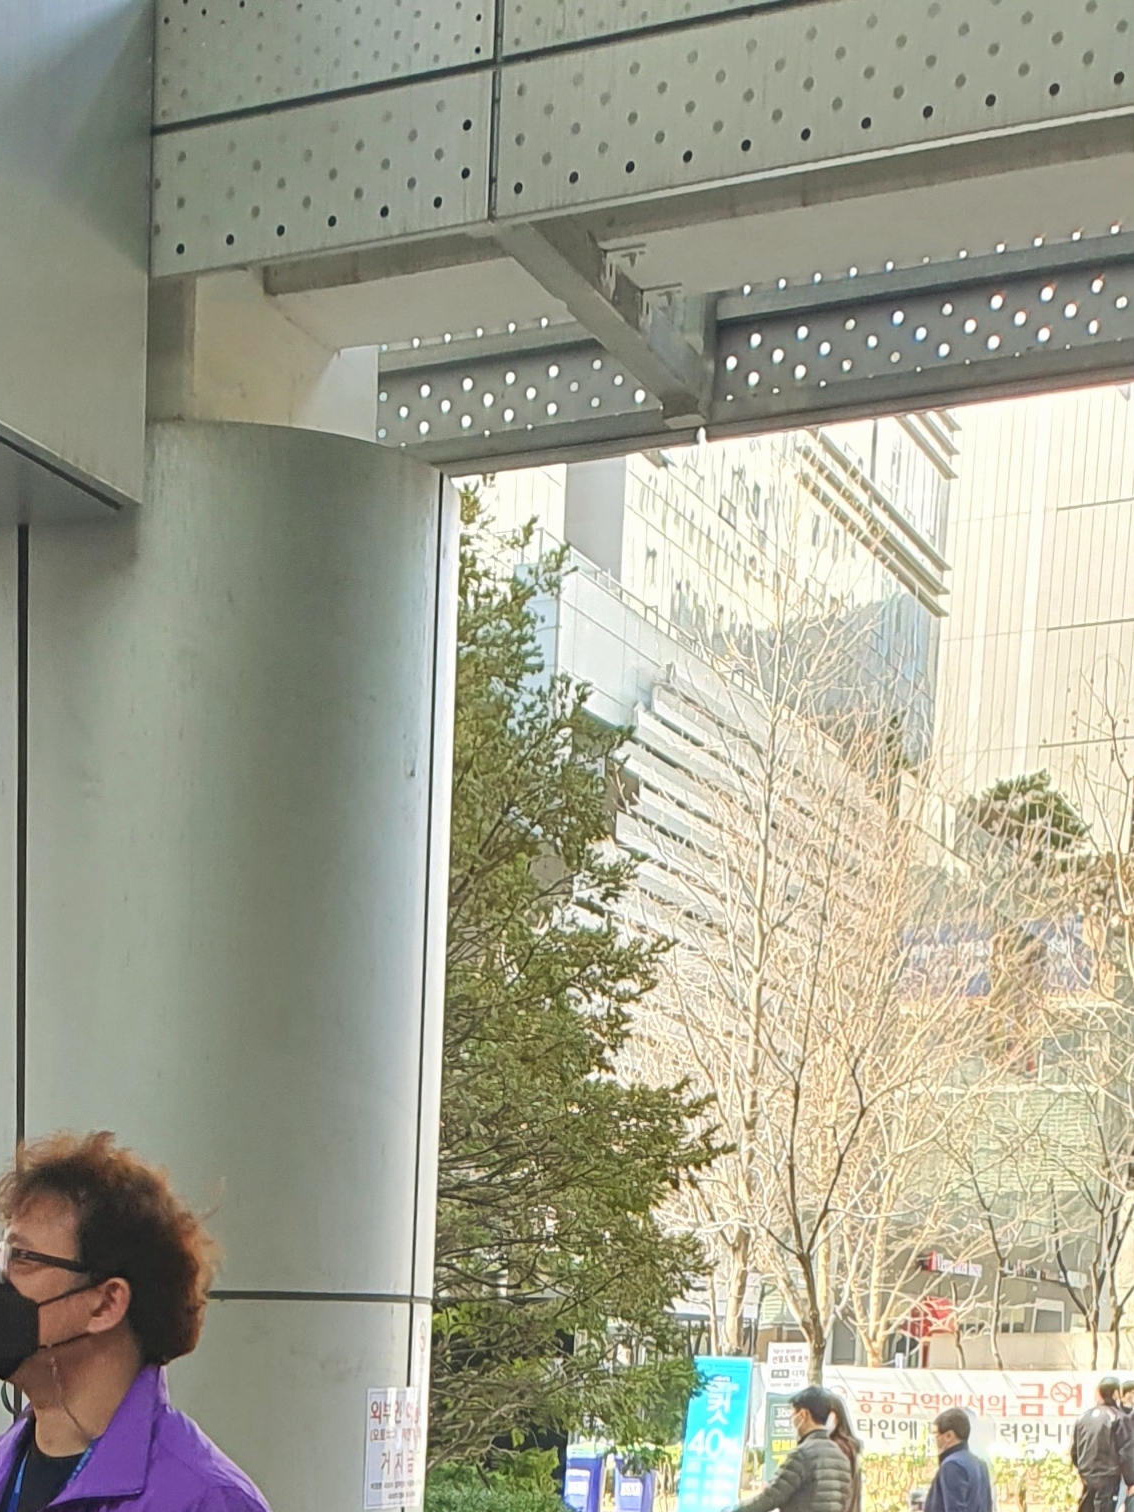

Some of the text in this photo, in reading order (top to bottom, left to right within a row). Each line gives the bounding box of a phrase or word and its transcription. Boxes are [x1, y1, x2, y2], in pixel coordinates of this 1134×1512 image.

[857, 1381, 1083, 1418] 공공구역에서의 금연
[857, 1418, 918, 1440] 타인에
